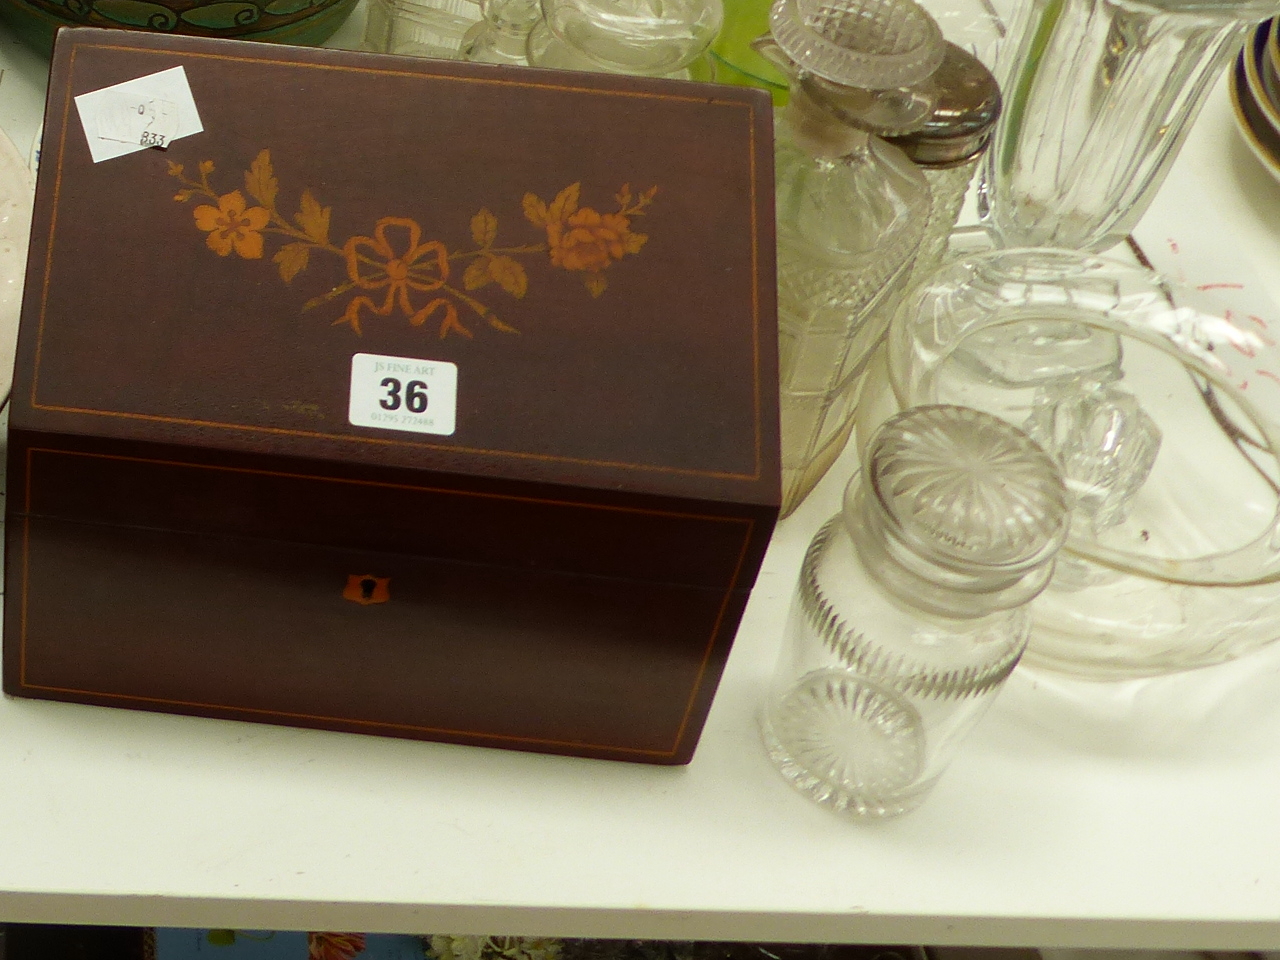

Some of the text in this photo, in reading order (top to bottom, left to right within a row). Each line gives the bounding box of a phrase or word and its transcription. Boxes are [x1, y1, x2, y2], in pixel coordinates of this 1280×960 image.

[374, 361, 436, 376] JS FINE ART
[378, 377, 429, 414] 36
